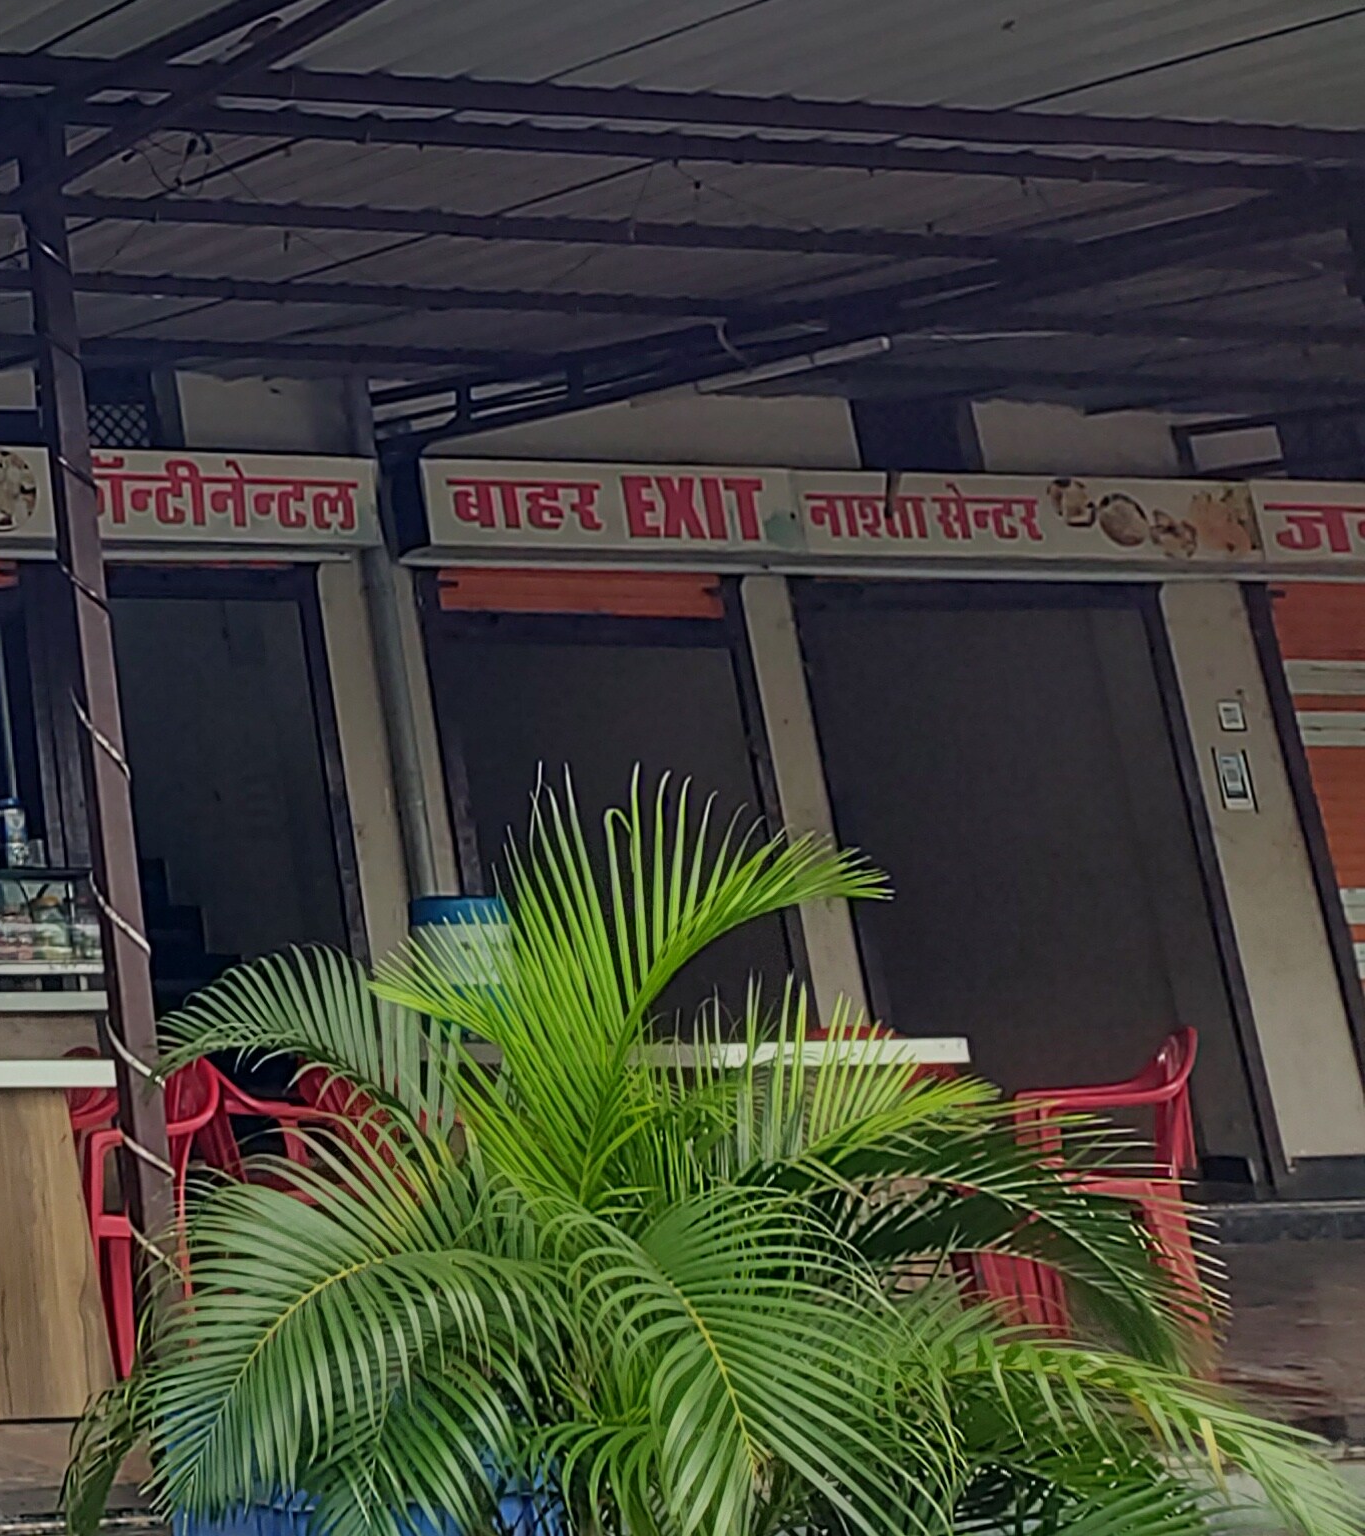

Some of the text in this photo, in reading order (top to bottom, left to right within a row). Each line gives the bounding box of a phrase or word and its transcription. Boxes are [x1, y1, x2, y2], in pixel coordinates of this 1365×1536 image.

[91, 456, 359, 531] ॉन्टीनेन्टल
[446, 474, 764, 542] बाहर EXIT
[804, 481, 1044, 541] नाश्ता सेन्टर
